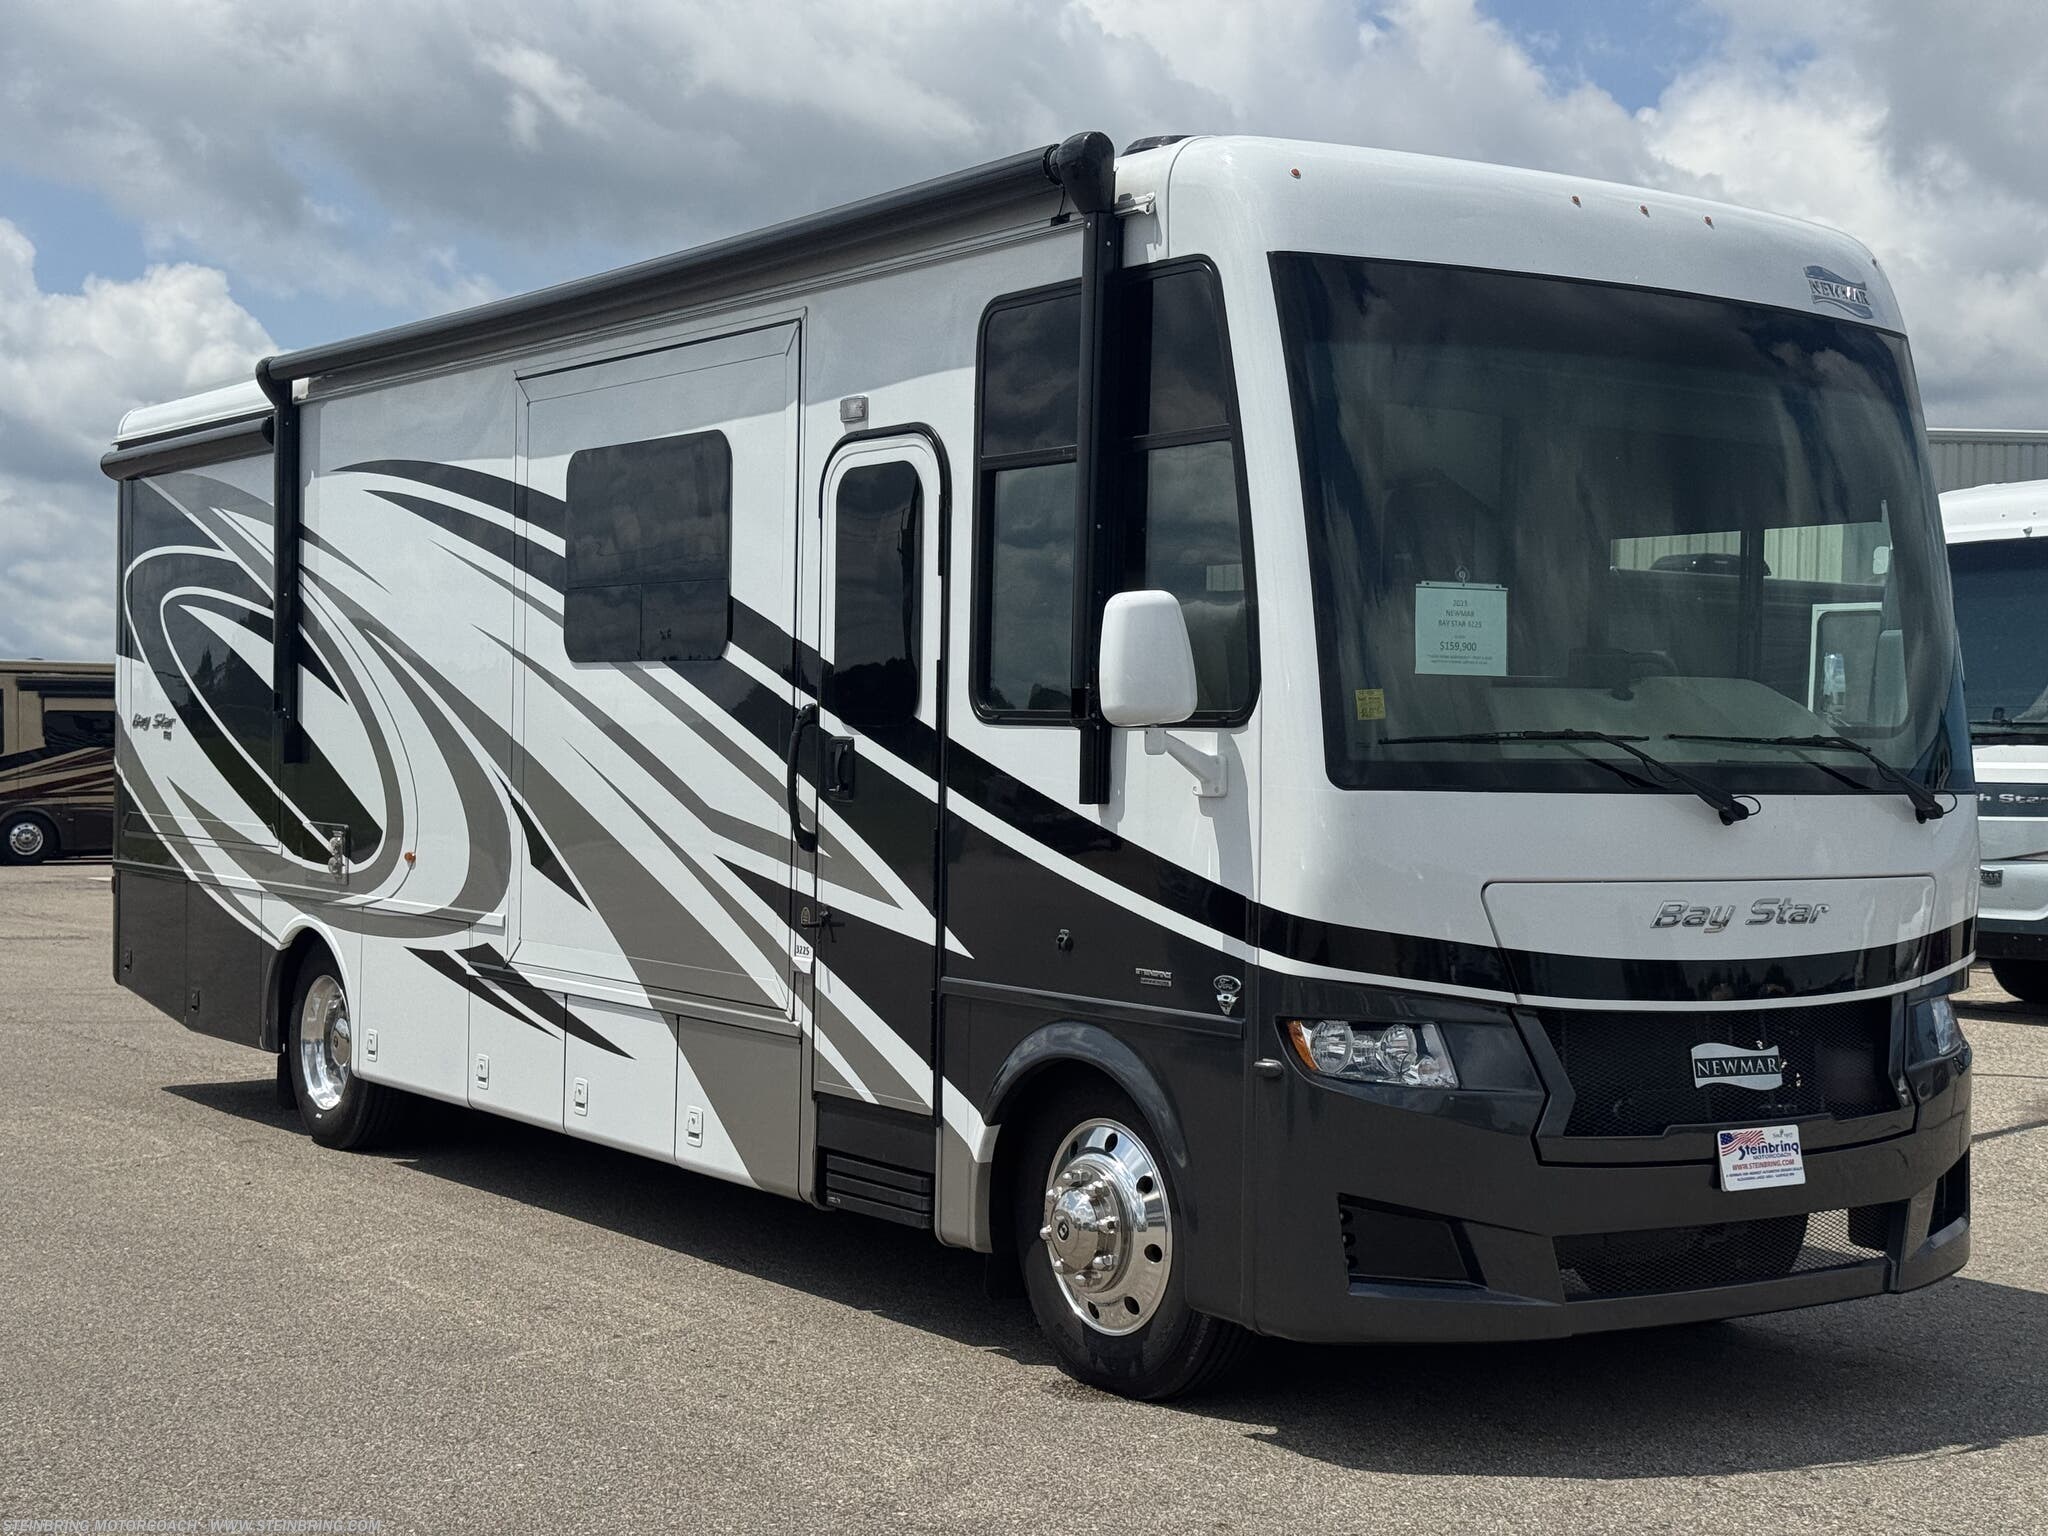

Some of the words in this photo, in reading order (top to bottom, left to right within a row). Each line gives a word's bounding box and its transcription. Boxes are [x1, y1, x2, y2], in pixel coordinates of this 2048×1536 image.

[1440, 641, 1477, 652] $159,900
[1650, 900, 1736, 934] Bay
[1745, 898, 1830, 925] Star
[1696, 1057, 1779, 1077] NEWMAR
[1738, 1140, 1799, 1160] Steinbring
